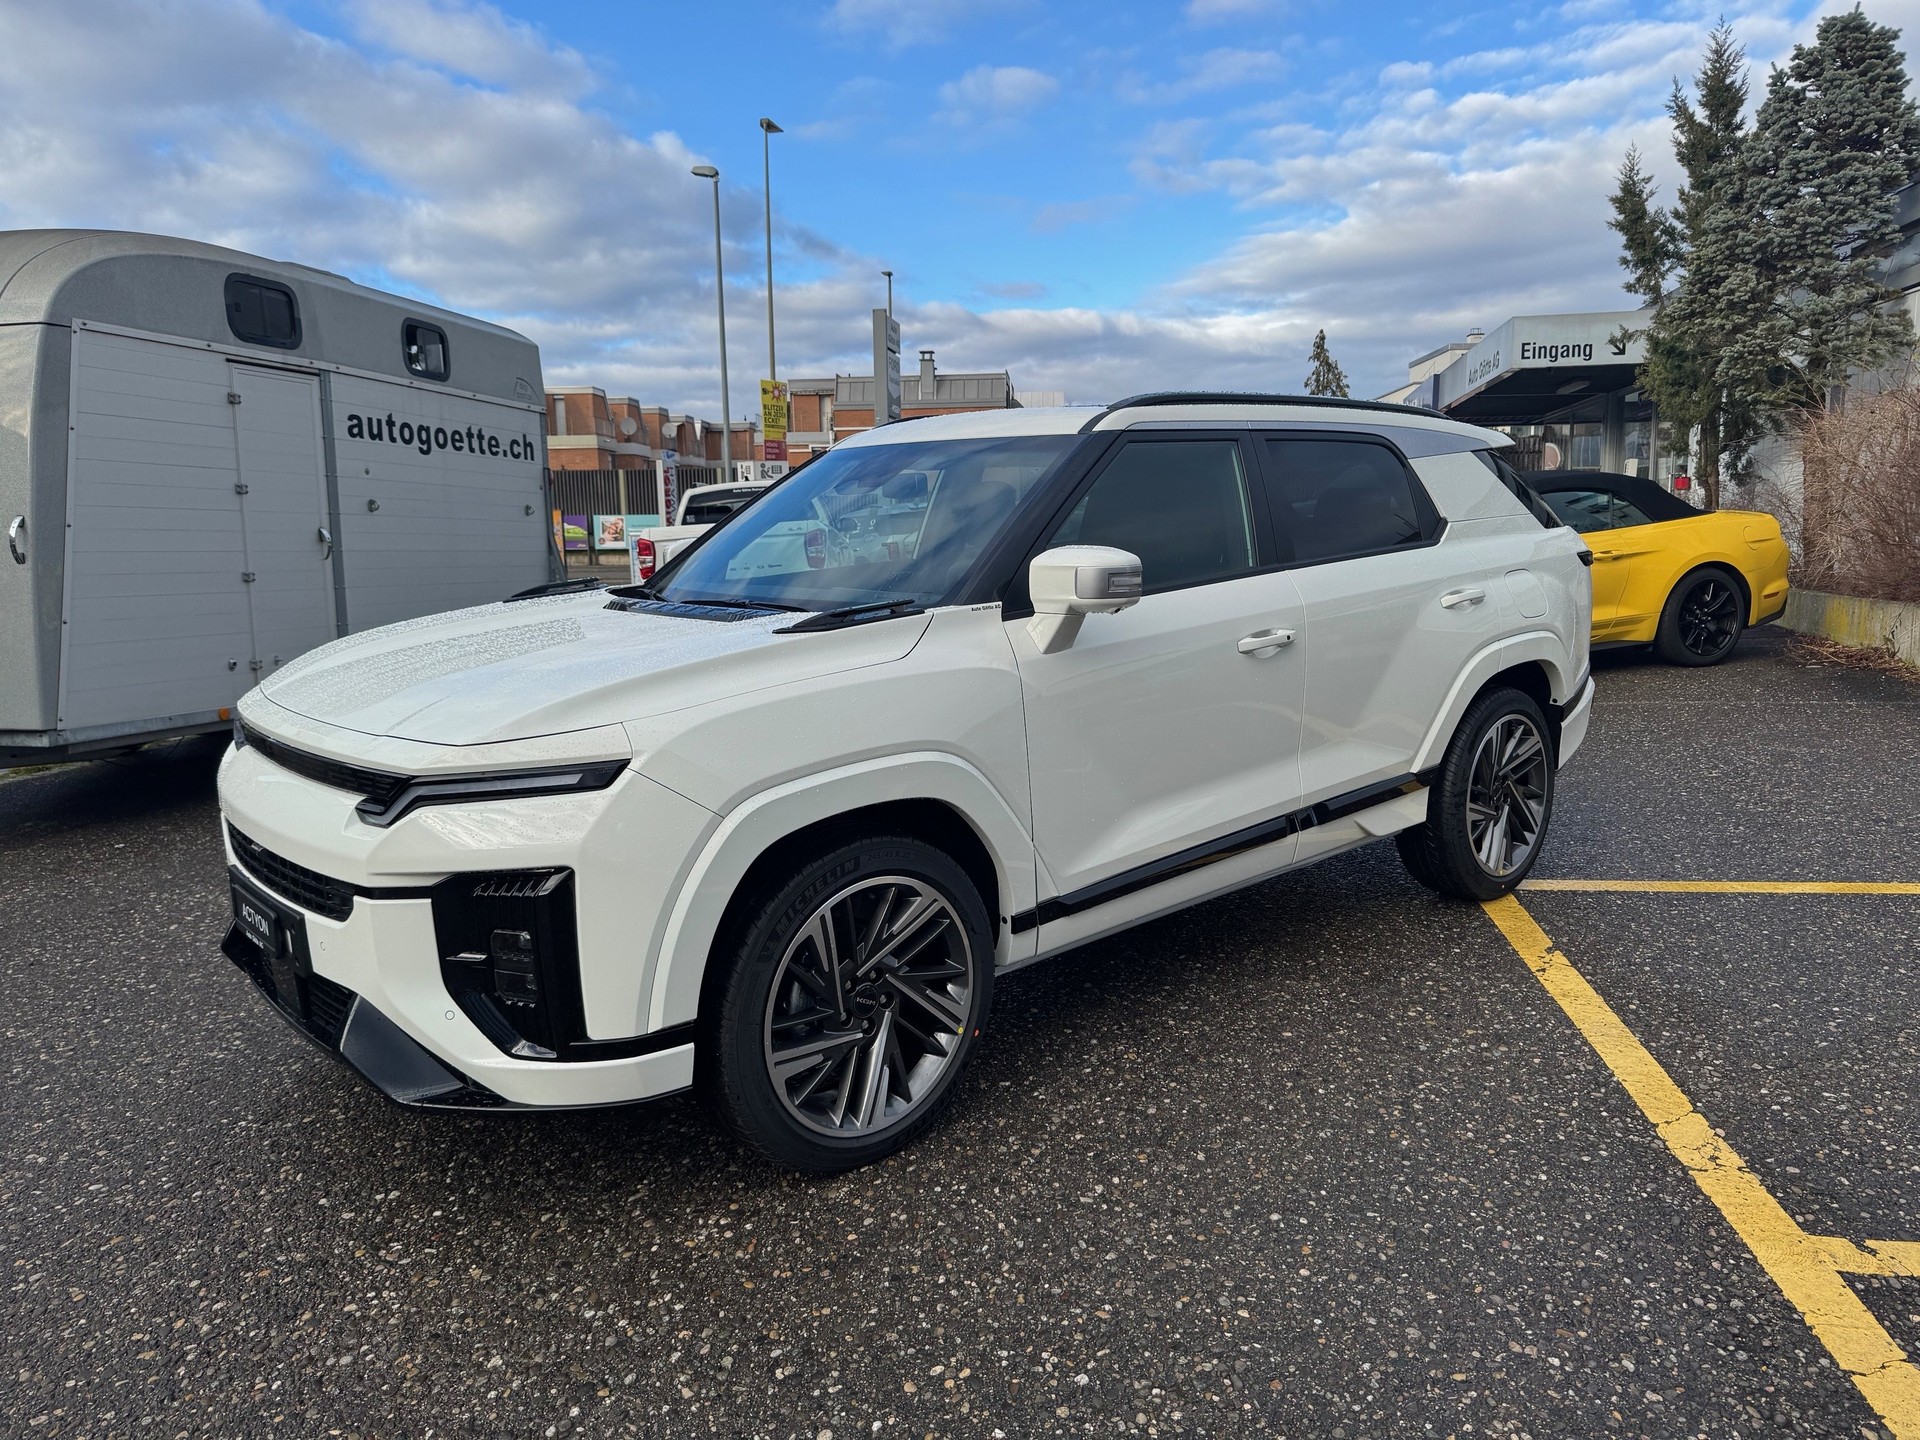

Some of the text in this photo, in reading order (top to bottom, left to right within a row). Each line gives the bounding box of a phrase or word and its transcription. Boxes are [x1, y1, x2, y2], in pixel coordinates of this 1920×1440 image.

[1468, 368, 1479, 386] Auto
[1492, 350, 1500, 371] AG
[1521, 342, 1593, 362] Eingang
[764, 410, 772, 418] AN
[347, 412, 535, 461] autogoette.ch
[774, 859, 855, 937] MICHELIN
[242, 903, 270, 936] ACTYON
[856, 996, 876, 1006] KGM
